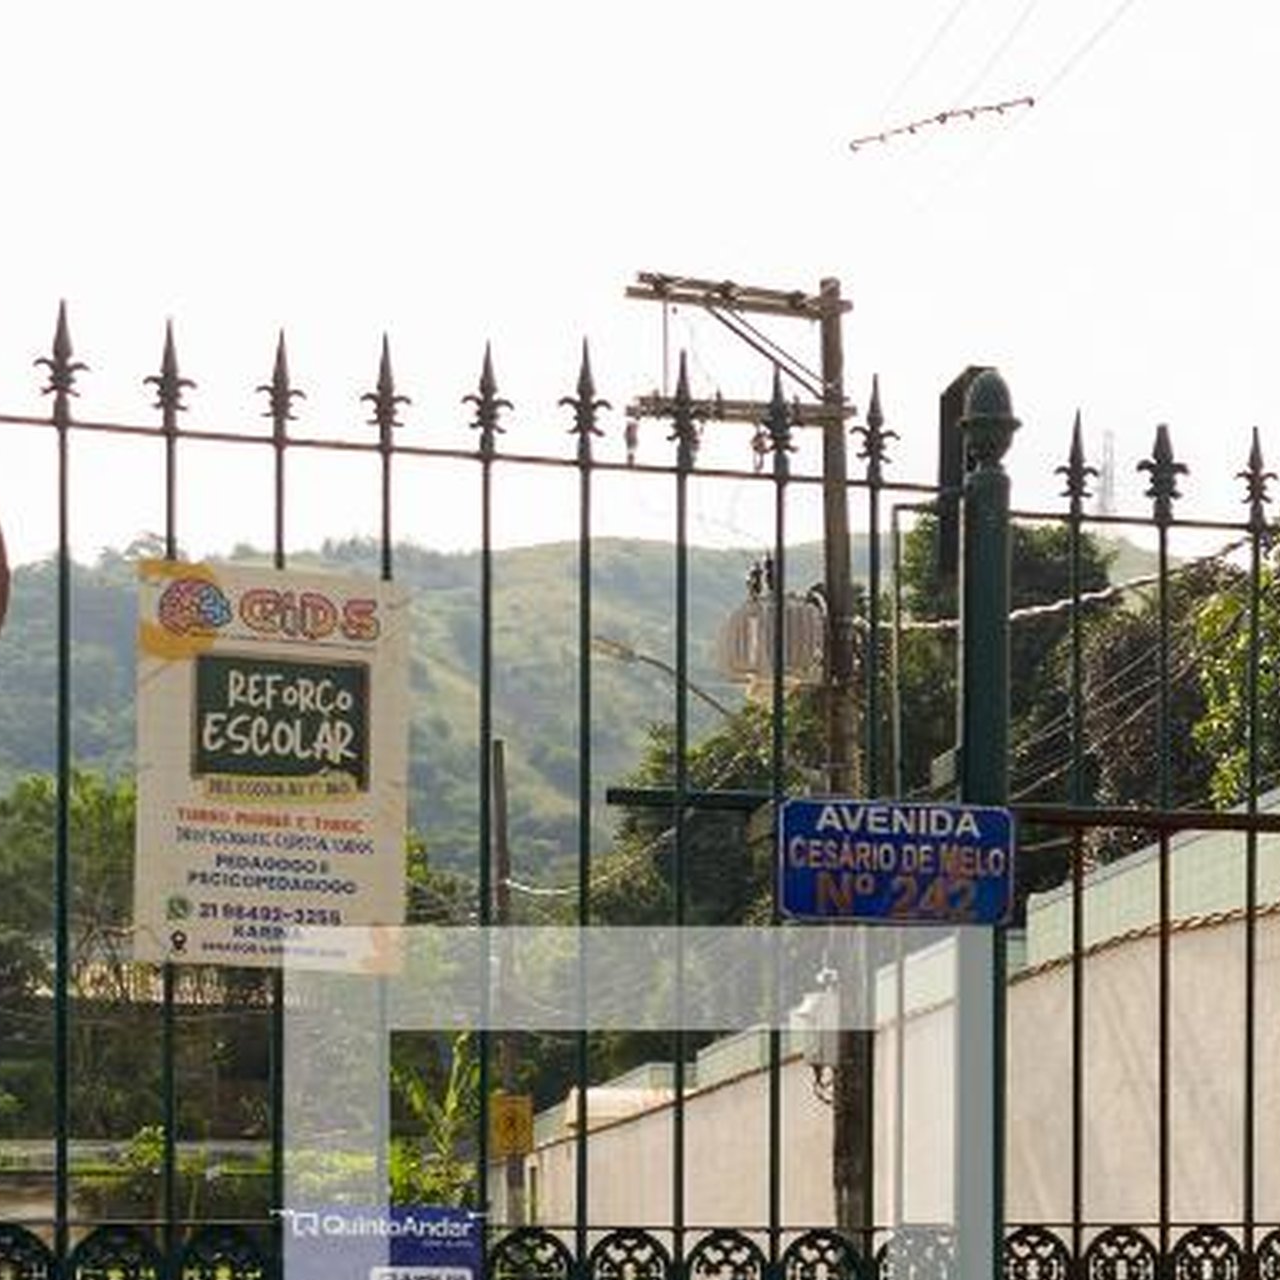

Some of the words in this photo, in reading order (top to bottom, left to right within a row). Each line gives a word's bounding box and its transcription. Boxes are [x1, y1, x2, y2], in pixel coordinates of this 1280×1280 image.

[228, 670, 353, 714] REFORÇO
[203, 712, 358, 764] ESCOLAR
[816, 806, 982, 839] AVENIDA
[215, 854, 318, 873] PEDAGOGO
[902, 843, 935, 874] DE
[941, 843, 1005, 877] MELO
[199, 902, 218, 918] 21
[322, 1215, 474, 1237] QuintoAndar
